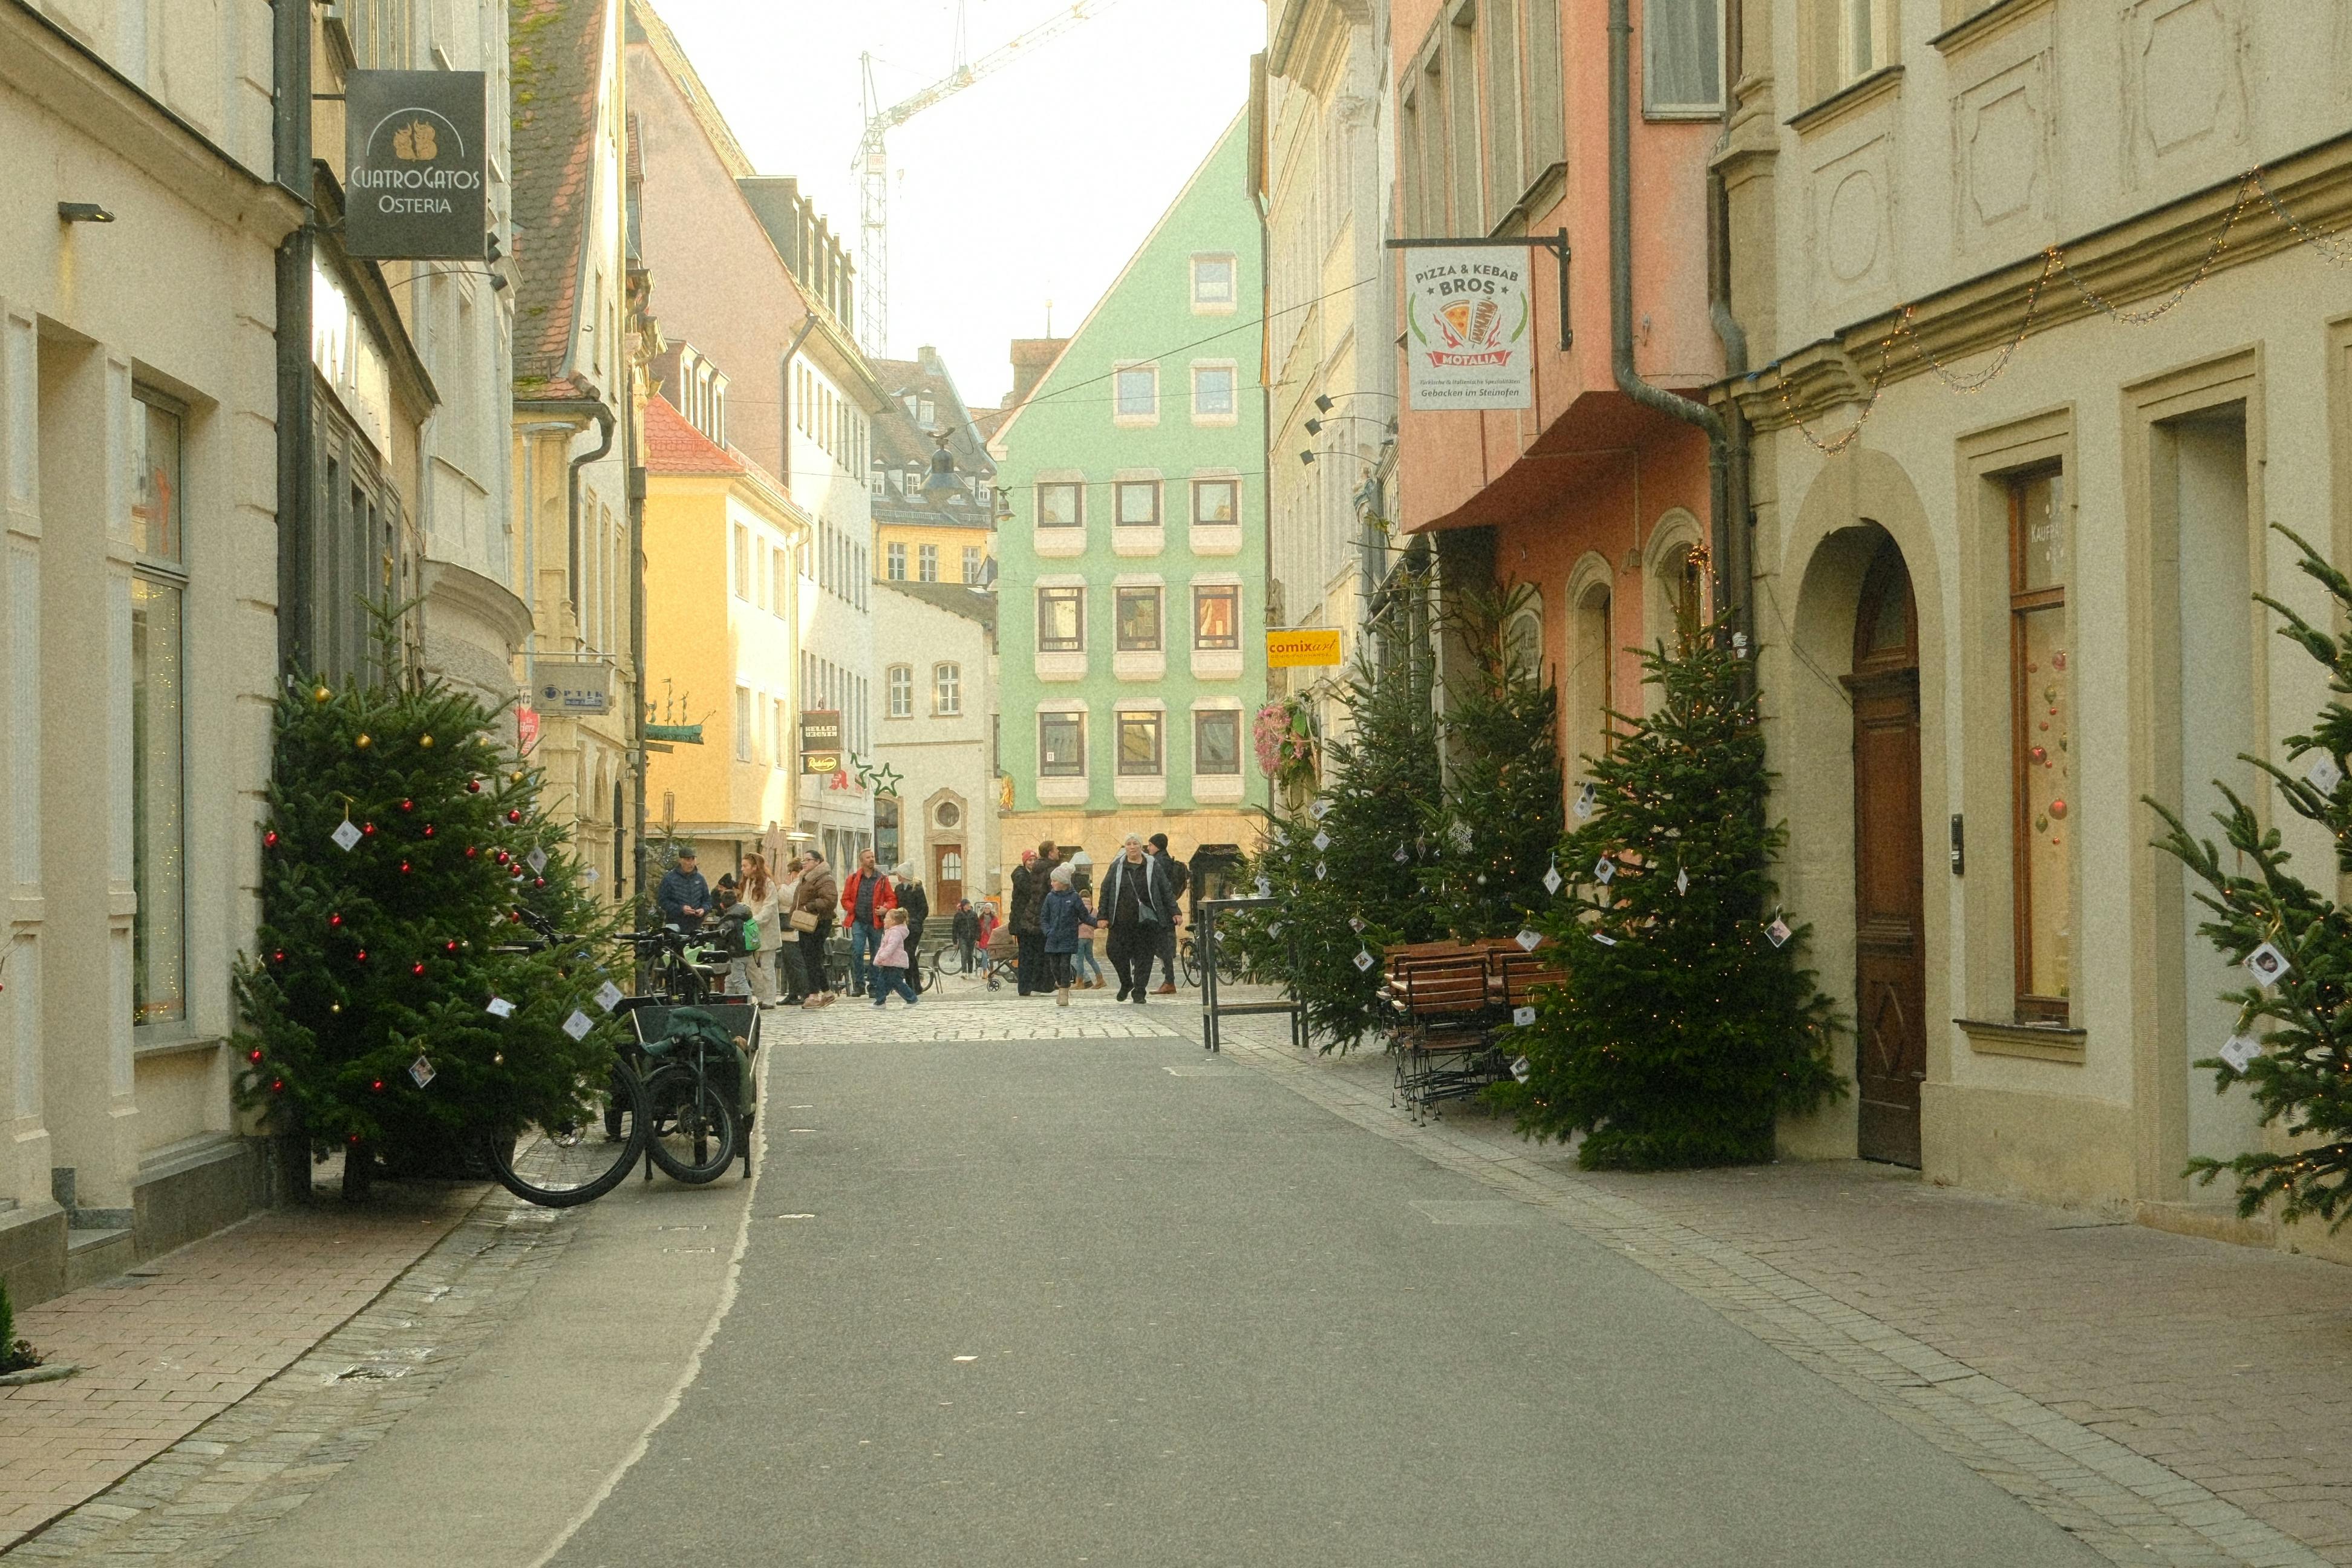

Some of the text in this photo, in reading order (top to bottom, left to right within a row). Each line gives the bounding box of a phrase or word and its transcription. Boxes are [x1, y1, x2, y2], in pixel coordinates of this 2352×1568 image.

[379, 195, 452, 213] OSTERIA
[1415, 264, 1518, 284] PIZZA & KEBAB
[1439, 278, 1495, 296] BROS
[1442, 354, 1499, 365] MOTALIA
[1479, 388, 1519, 397] Steinofen
